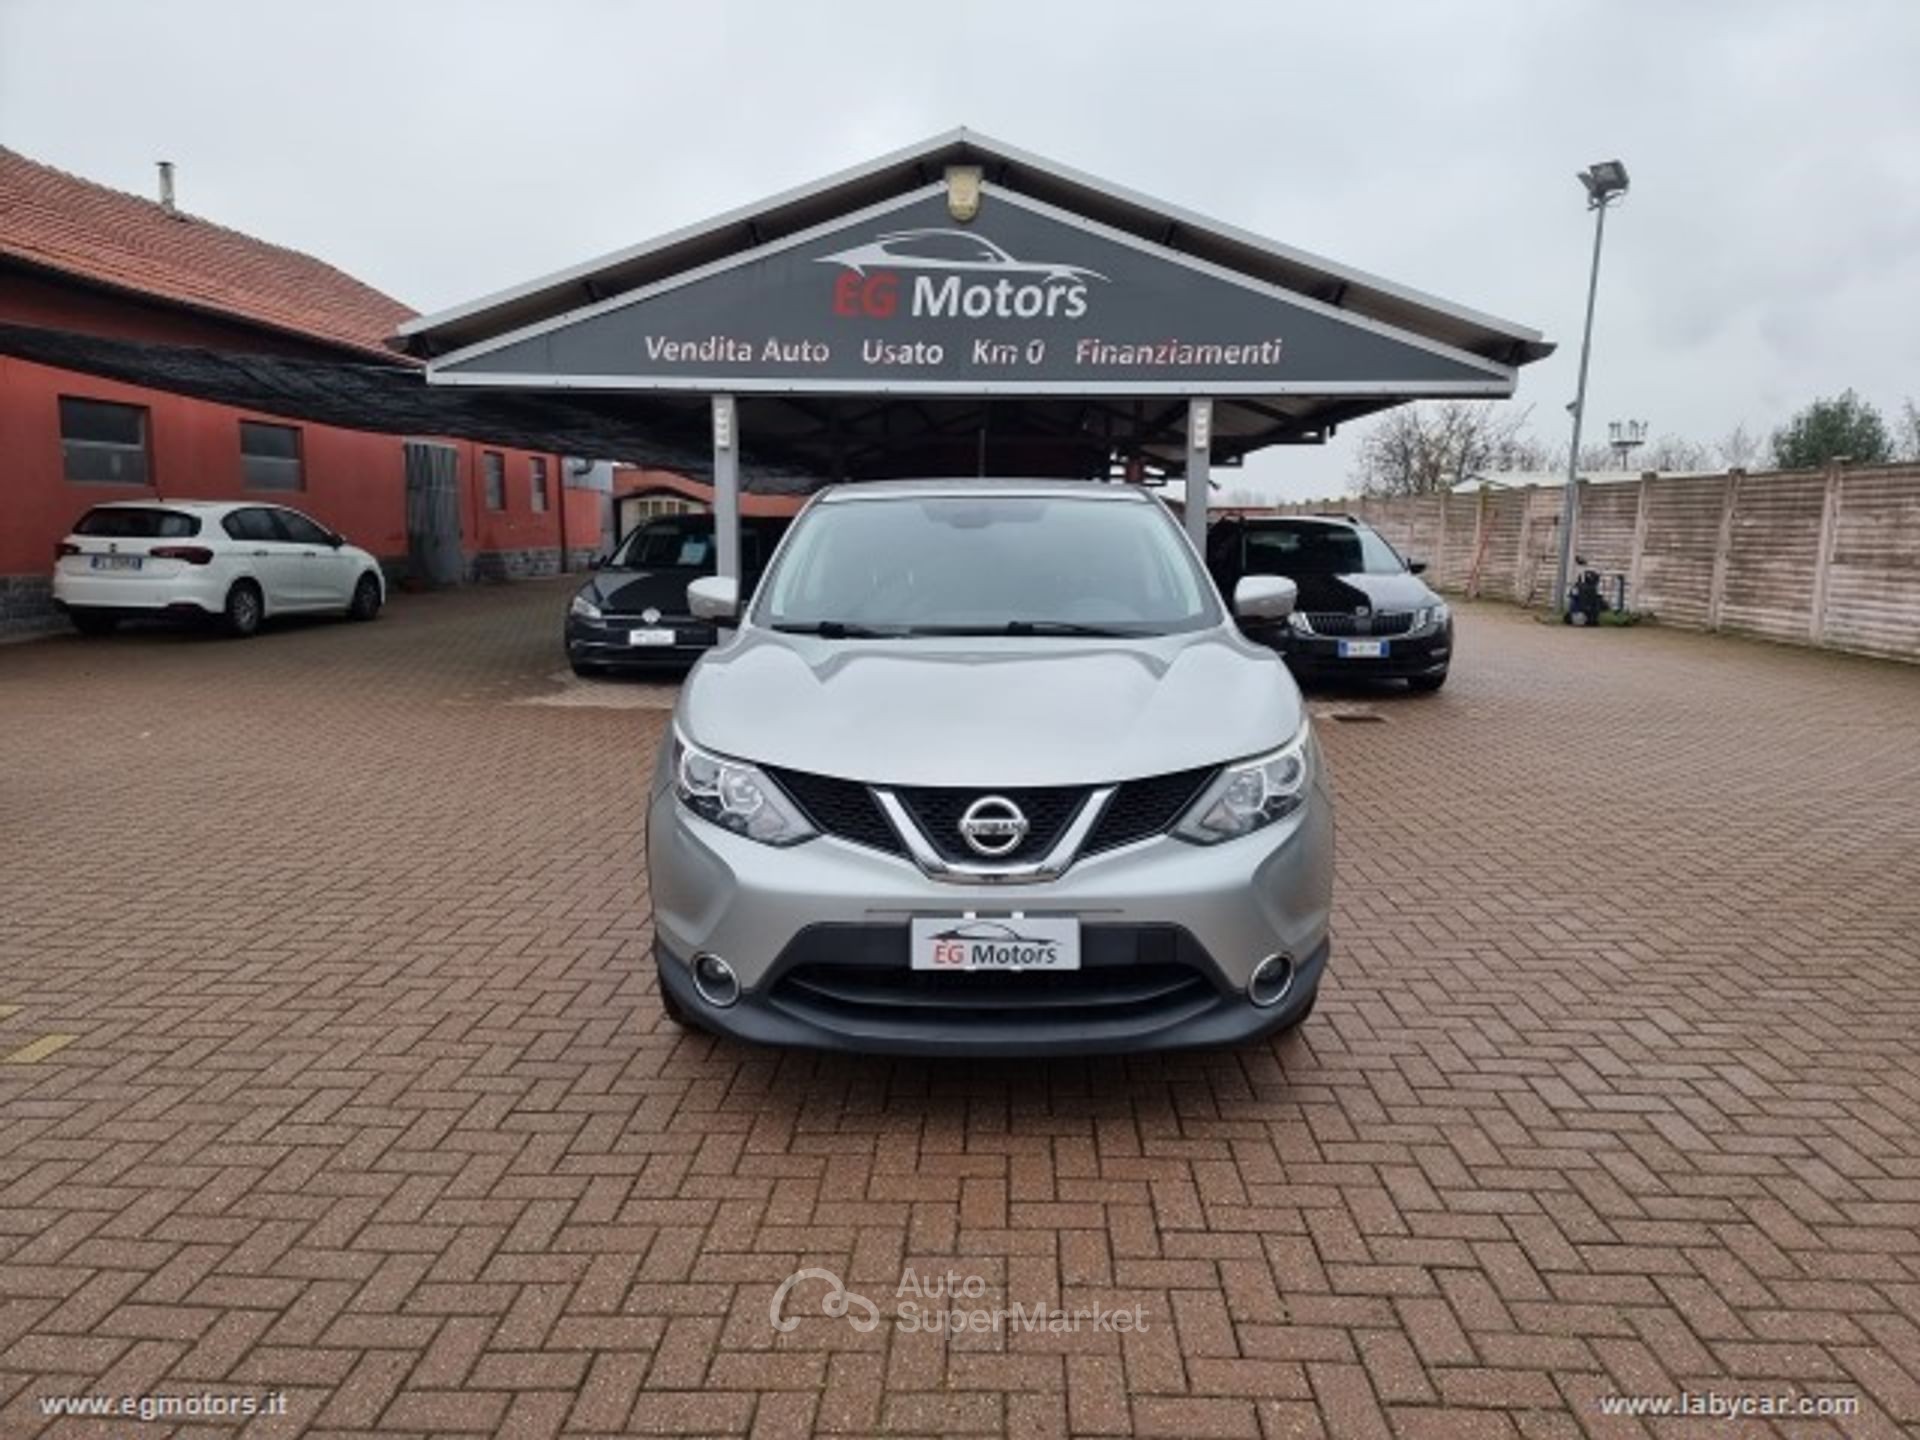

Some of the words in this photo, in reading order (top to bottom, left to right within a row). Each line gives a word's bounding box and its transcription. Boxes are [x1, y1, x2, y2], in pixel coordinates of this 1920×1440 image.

[832, 271, 898, 318] EG
[911, 275, 1087, 318] Motors
[645, 336, 752, 362] Vendita
[761, 337, 831, 363] Auto
[862, 339, 945, 365] Usato
[971, 339, 1018, 365] Km
[1026, 339, 1045, 365] 0
[1075, 339, 1283, 365] Finanziamenti
[934, 944, 965, 964] EG
[971, 944, 1058, 965] Motors
